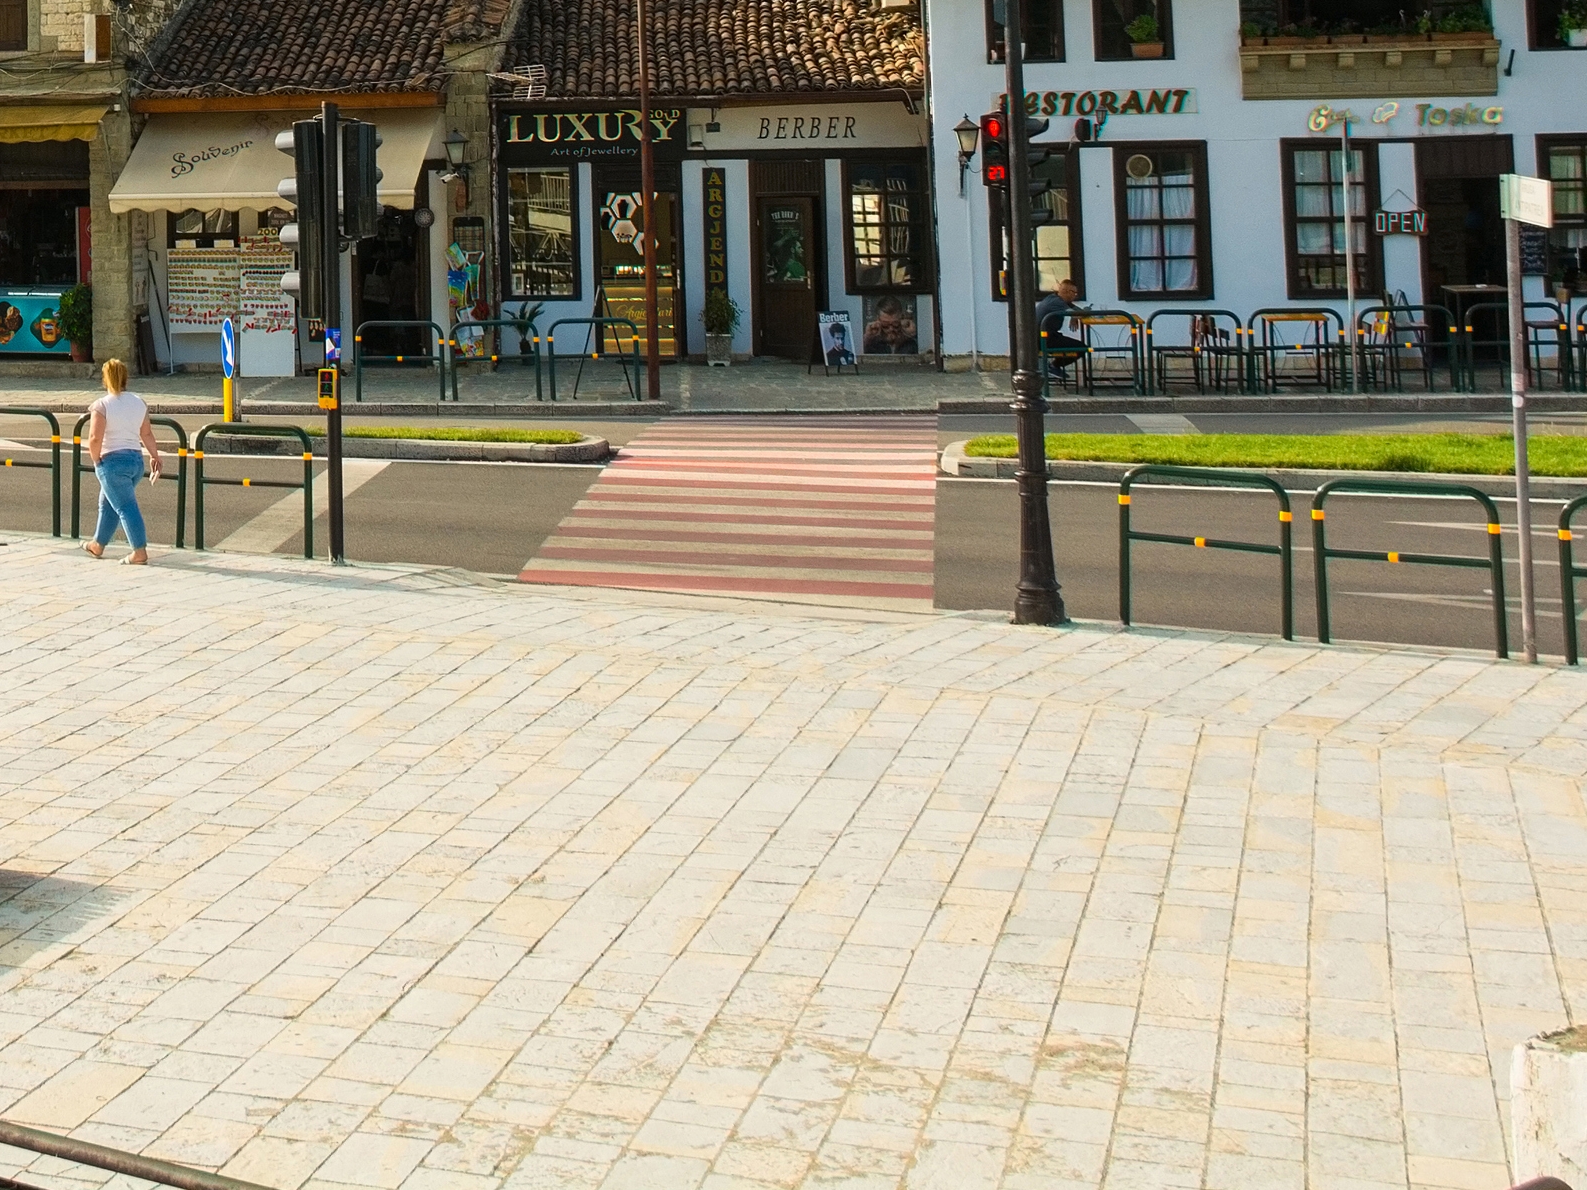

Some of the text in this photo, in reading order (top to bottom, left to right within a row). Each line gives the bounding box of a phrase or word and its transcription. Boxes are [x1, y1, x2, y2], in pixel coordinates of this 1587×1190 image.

[1416, 102, 1504, 126] Toska
[507, 110, 678, 143] LUXURY
[757, 116, 857, 139] BERBER
[171, 140, 253, 179] Souvenir
[550, 146, 638, 157] Art of Jewellery
[257, 228, 277, 236] 200
[1375, 212, 1426, 233] OPEN
[819, 312, 849, 323] Berber
